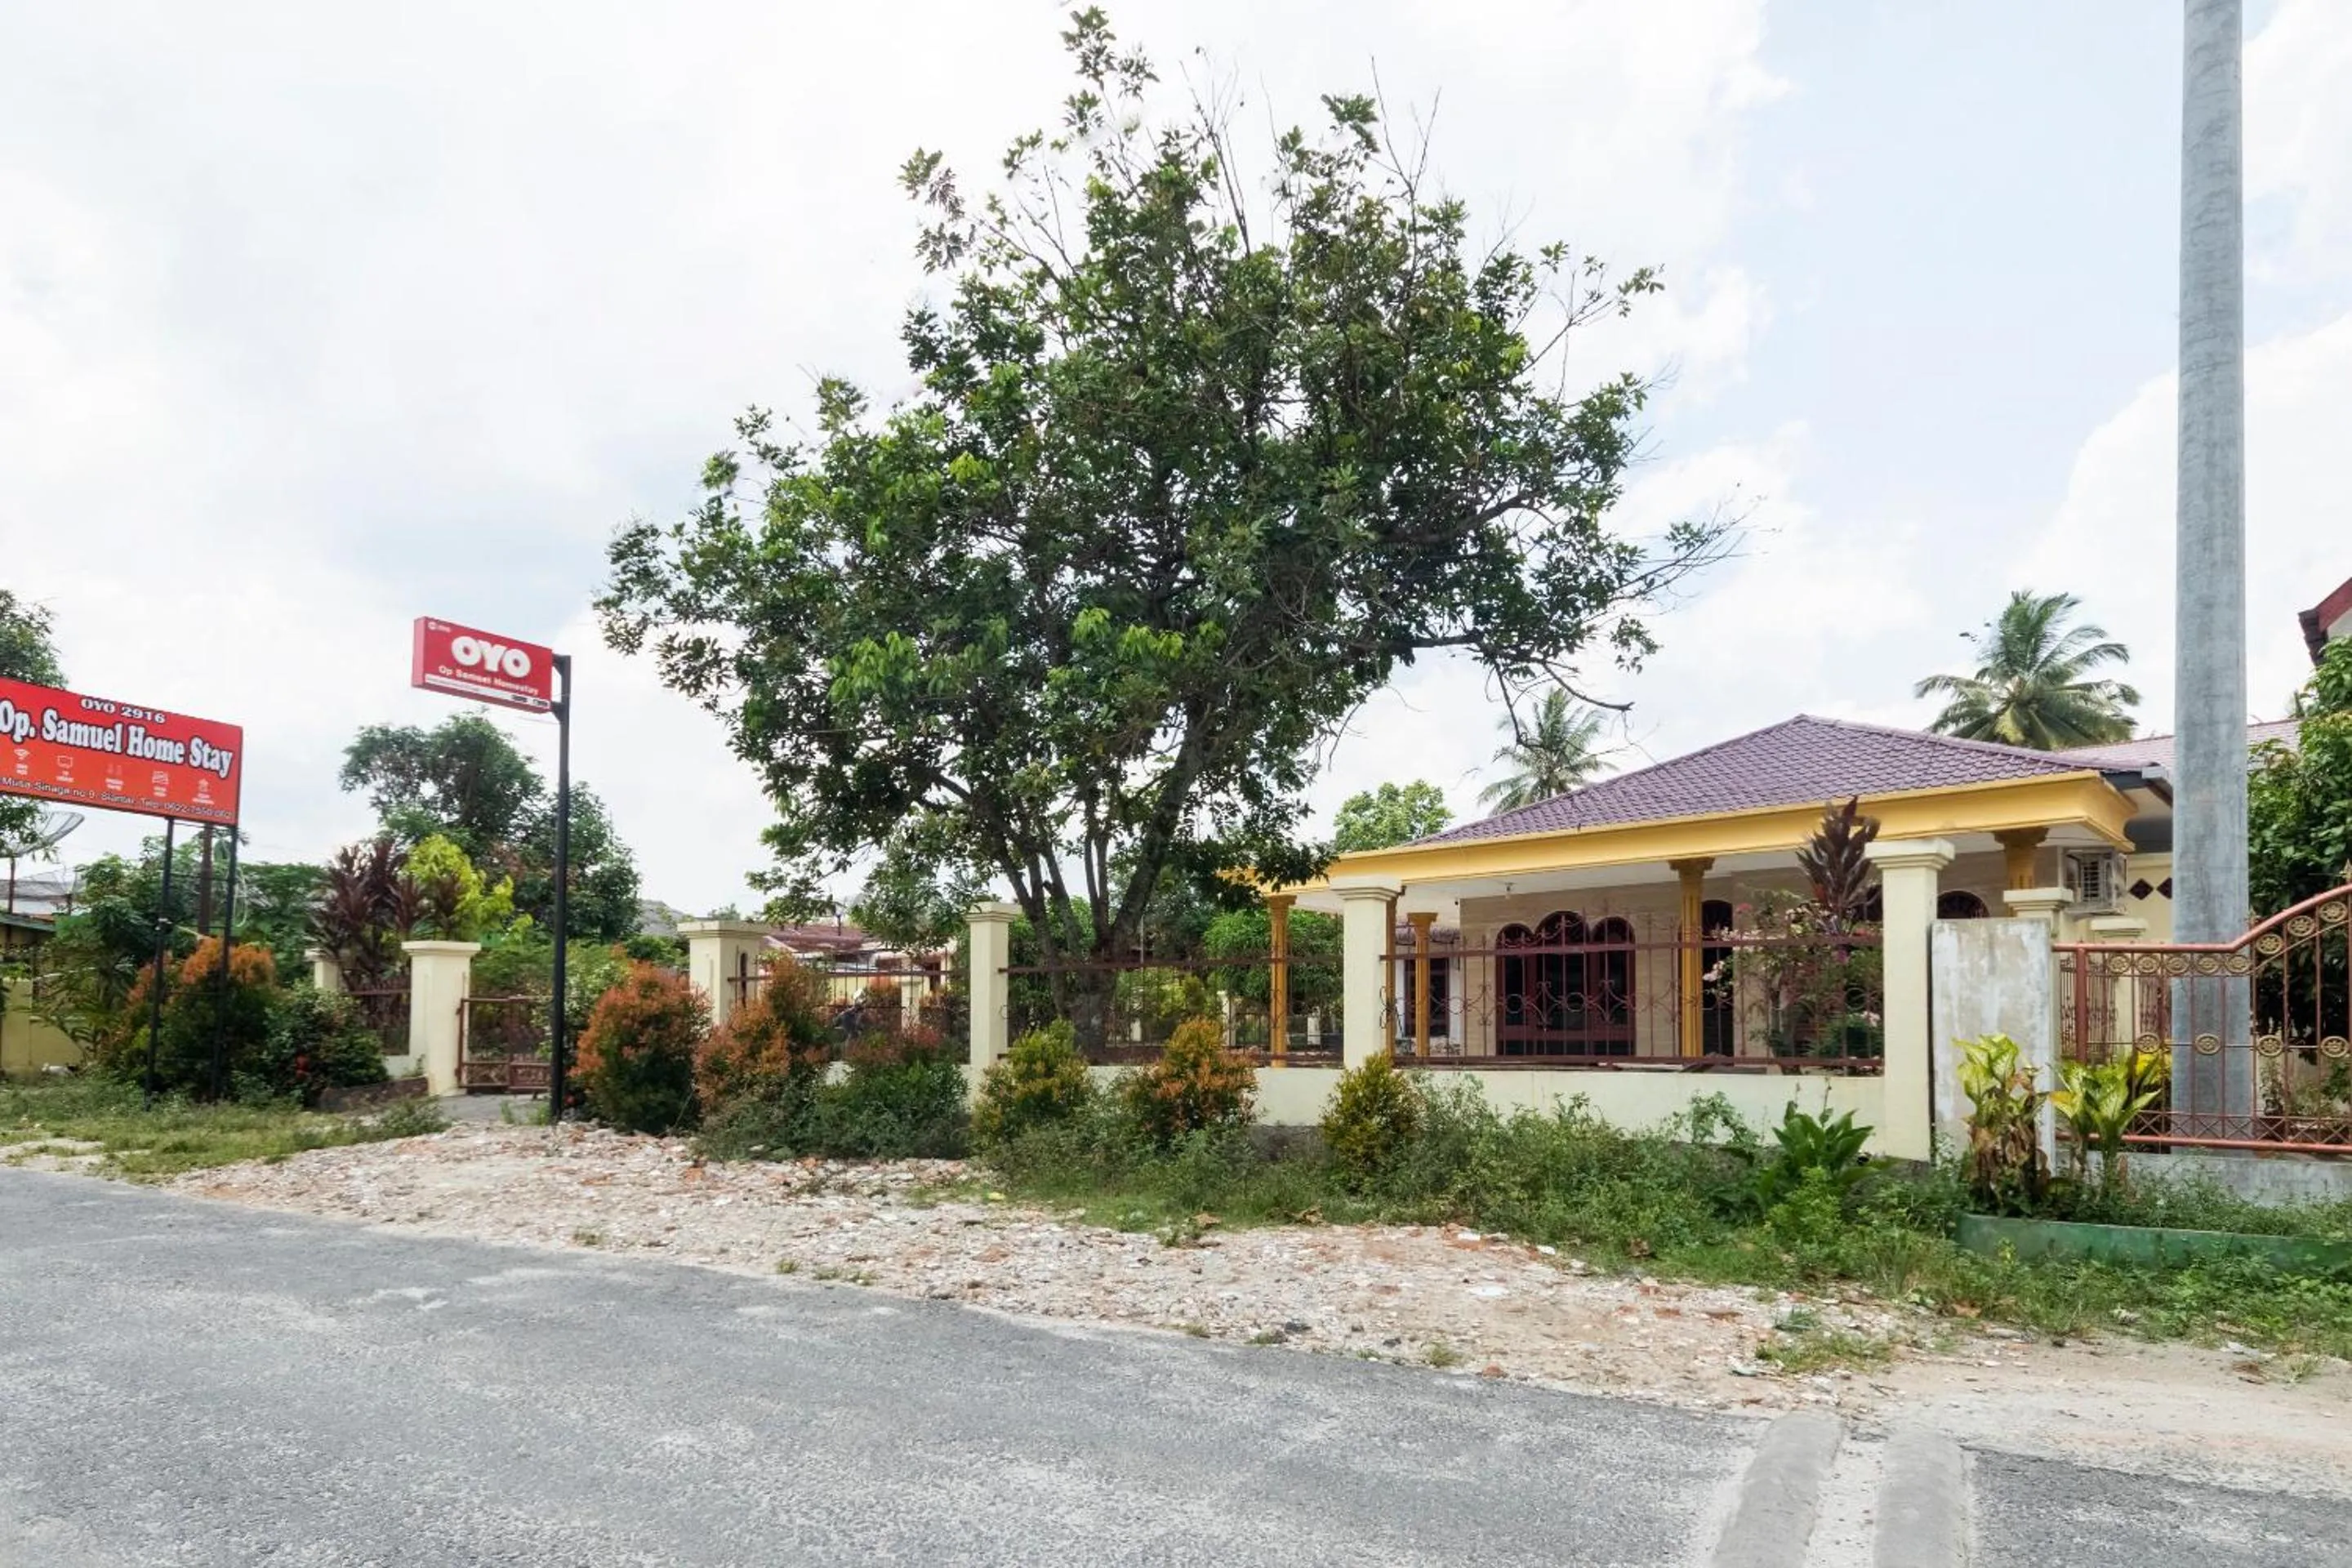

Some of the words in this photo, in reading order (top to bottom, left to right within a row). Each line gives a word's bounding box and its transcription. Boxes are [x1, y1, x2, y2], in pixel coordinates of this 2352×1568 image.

[452, 636, 531, 678] OYO
[439, 665, 452, 676] Op
[456, 669, 492, 684] Samuel
[494, 676, 539, 697] Homestay
[81, 698, 116, 714] OYO
[121, 706, 166, 724] 2916
[0, 700, 36, 742] Op.
[42, 708, 123, 753] Samuel
[127, 724, 185, 764] Home
[189, 737, 233, 778] Stay
